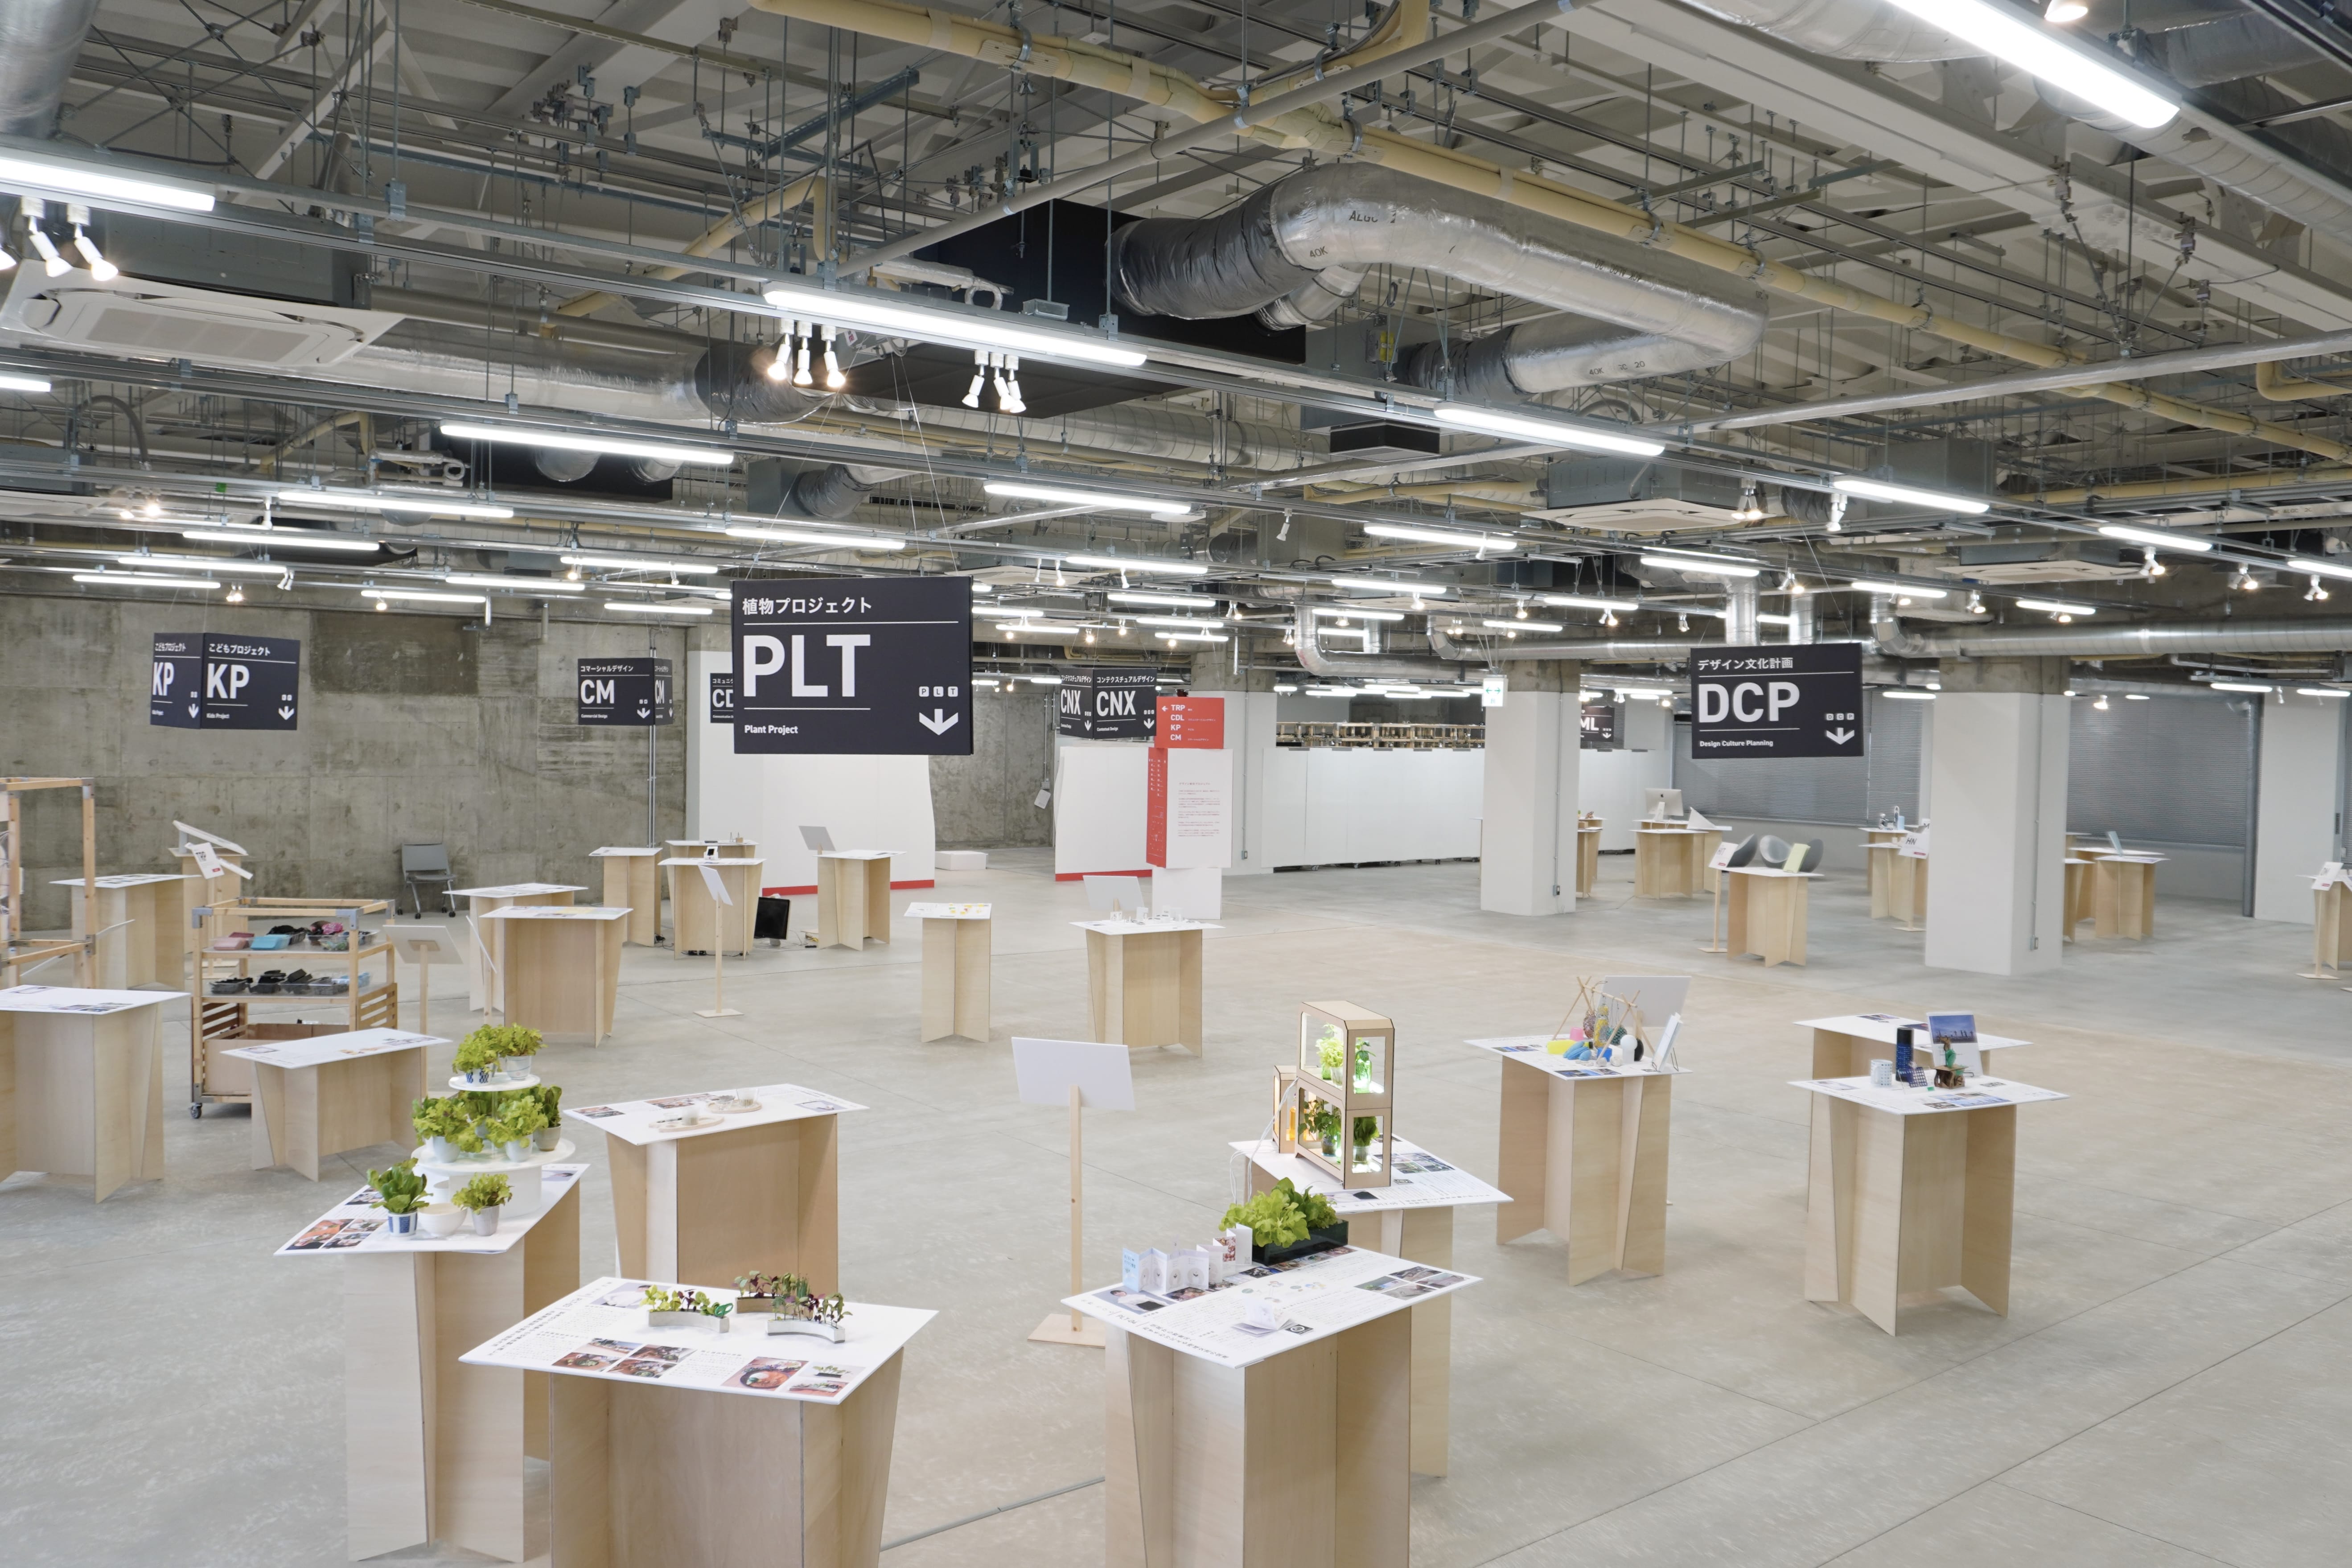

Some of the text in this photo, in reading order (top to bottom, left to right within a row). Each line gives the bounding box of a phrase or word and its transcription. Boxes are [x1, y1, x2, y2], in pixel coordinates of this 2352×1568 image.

[1309, 246, 1328, 258] 40K
[742, 597, 872, 615] 植物プロジェクト
[209, 643, 271, 656] こどもプロジェクト
[743, 634, 871, 697] PLT
[1698, 657, 1793, 671] デザイン文化計画
[152, 662, 174, 696] KP
[206, 663, 250, 699] KP
[580, 679, 615, 704] CM
[655, 679, 665, 704] CM
[1097, 675, 1155, 683] コンテクスチュアルデザイン
[1061, 688, 1081, 716] CNX
[1096, 690, 1136, 717] CNX
[1698, 682, 1800, 723] DCP
[744, 724, 798, 736] Plant Project
